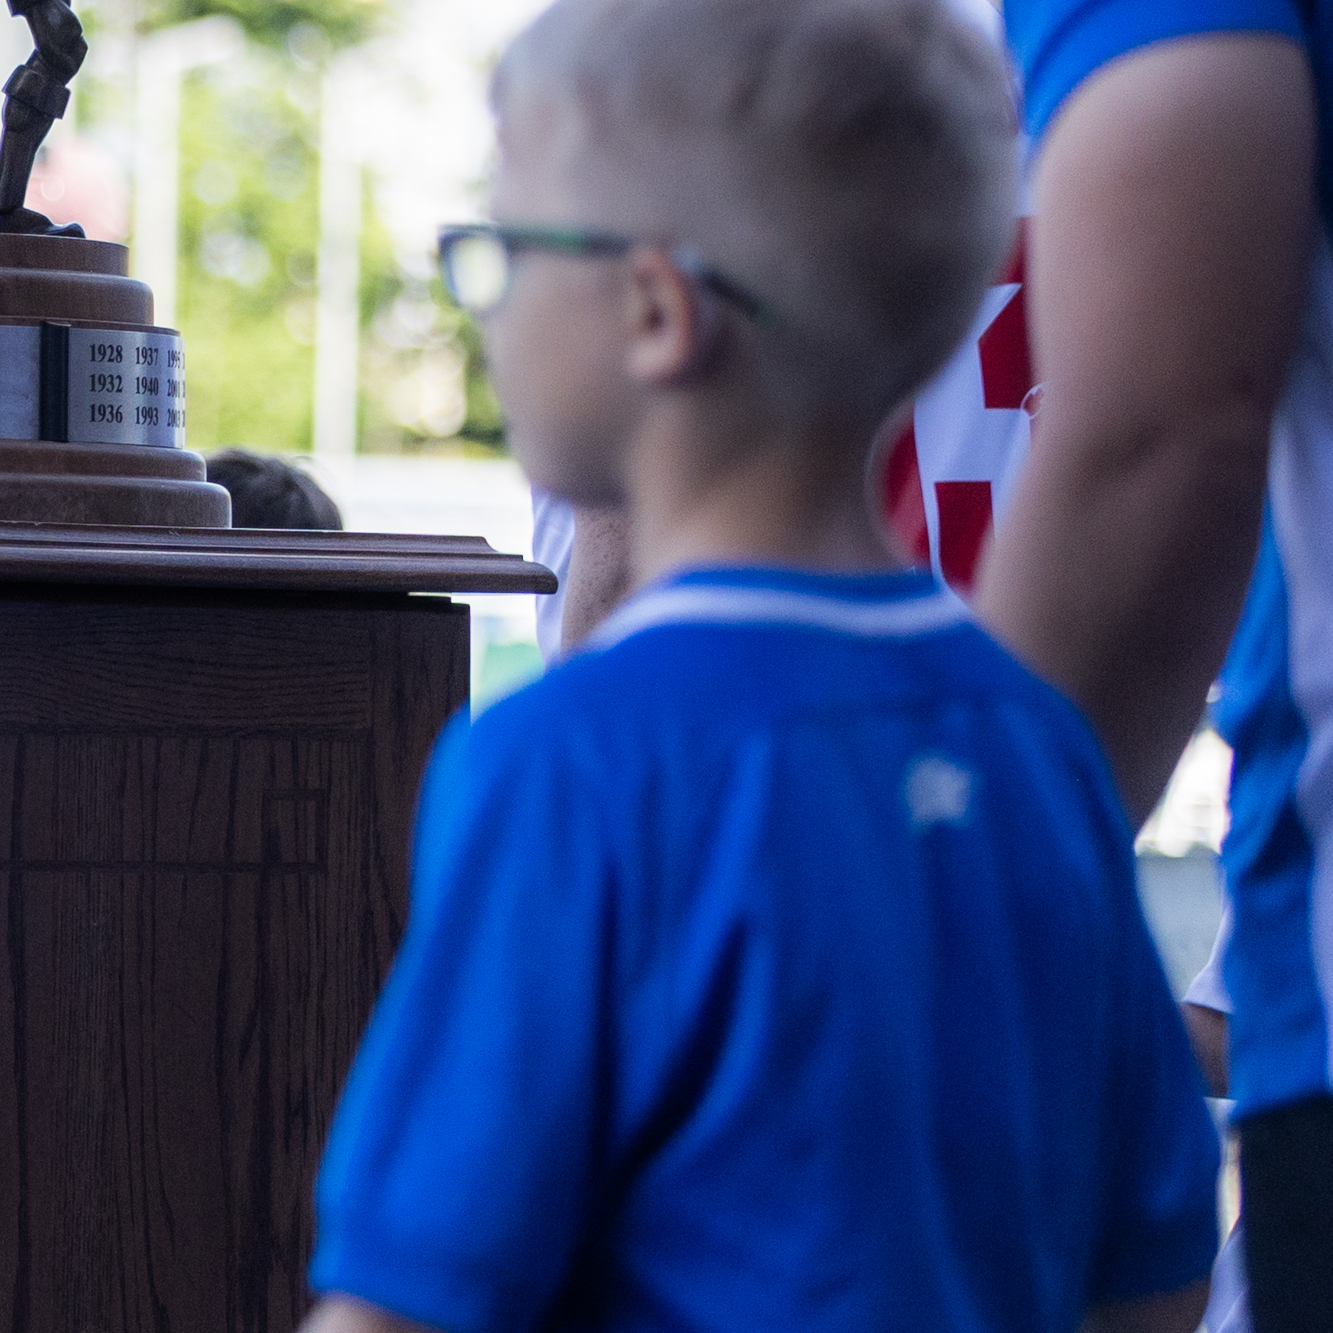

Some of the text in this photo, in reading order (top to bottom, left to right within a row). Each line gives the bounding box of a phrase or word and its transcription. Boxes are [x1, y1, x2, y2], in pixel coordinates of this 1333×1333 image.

[89, 343, 123, 364] 1928
[135, 346, 159, 366] 1937
[89, 373, 123, 393] 1932
[135, 376, 159, 396] 1940
[89, 403, 123, 424] 1936
[135, 406, 159, 426] 1993
